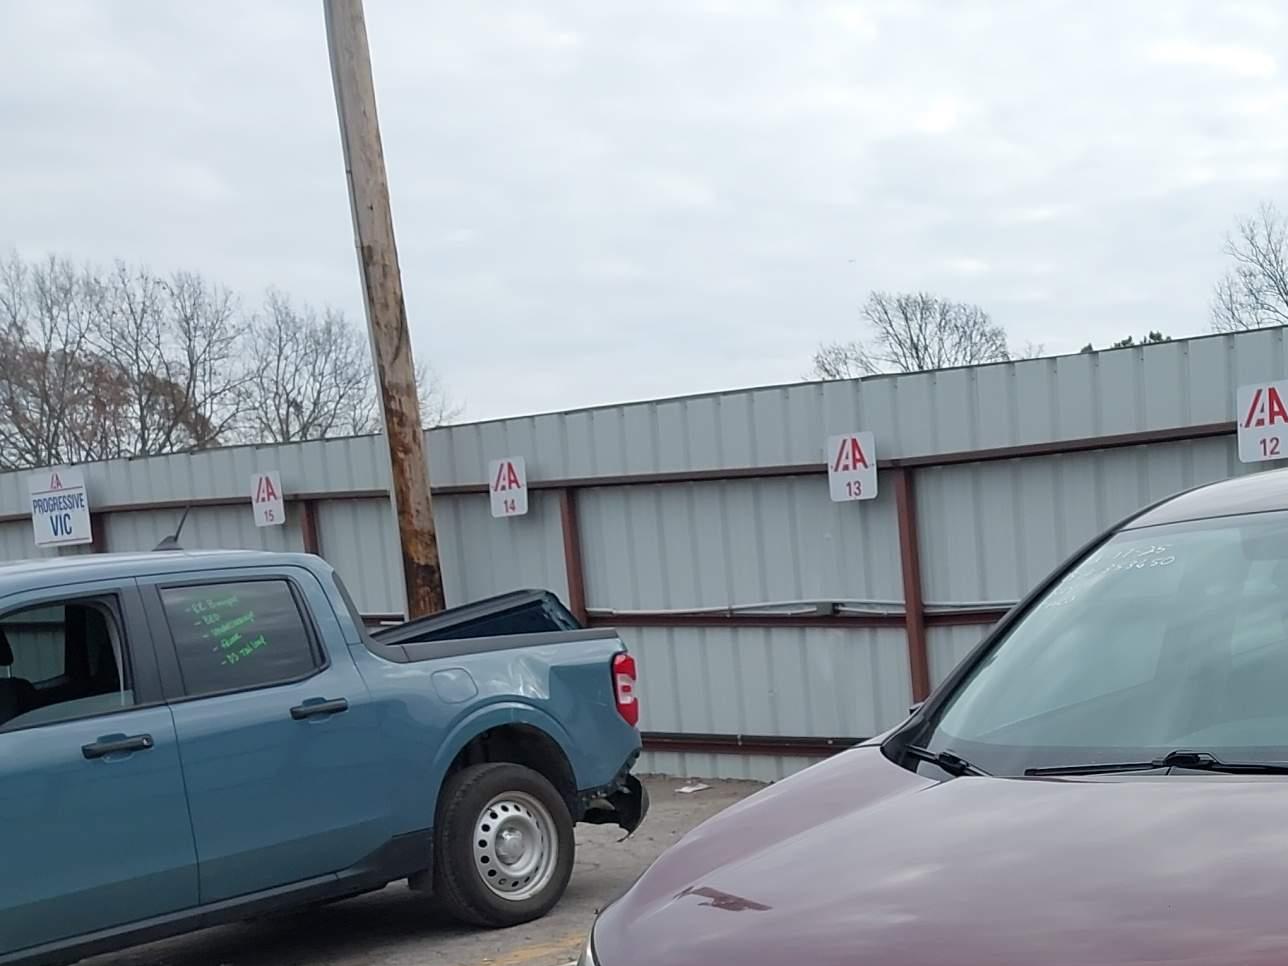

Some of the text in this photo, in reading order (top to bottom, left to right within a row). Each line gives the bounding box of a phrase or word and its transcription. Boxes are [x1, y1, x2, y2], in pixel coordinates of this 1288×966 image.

[1260, 437, 1280, 456] 12
[846, 481, 861, 496] 13
[32, 493, 85, 513] PROGRESSIVE
[504, 498, 515, 513] 14
[264, 509, 275, 522] 15
[49, 513, 73, 536] VIC
